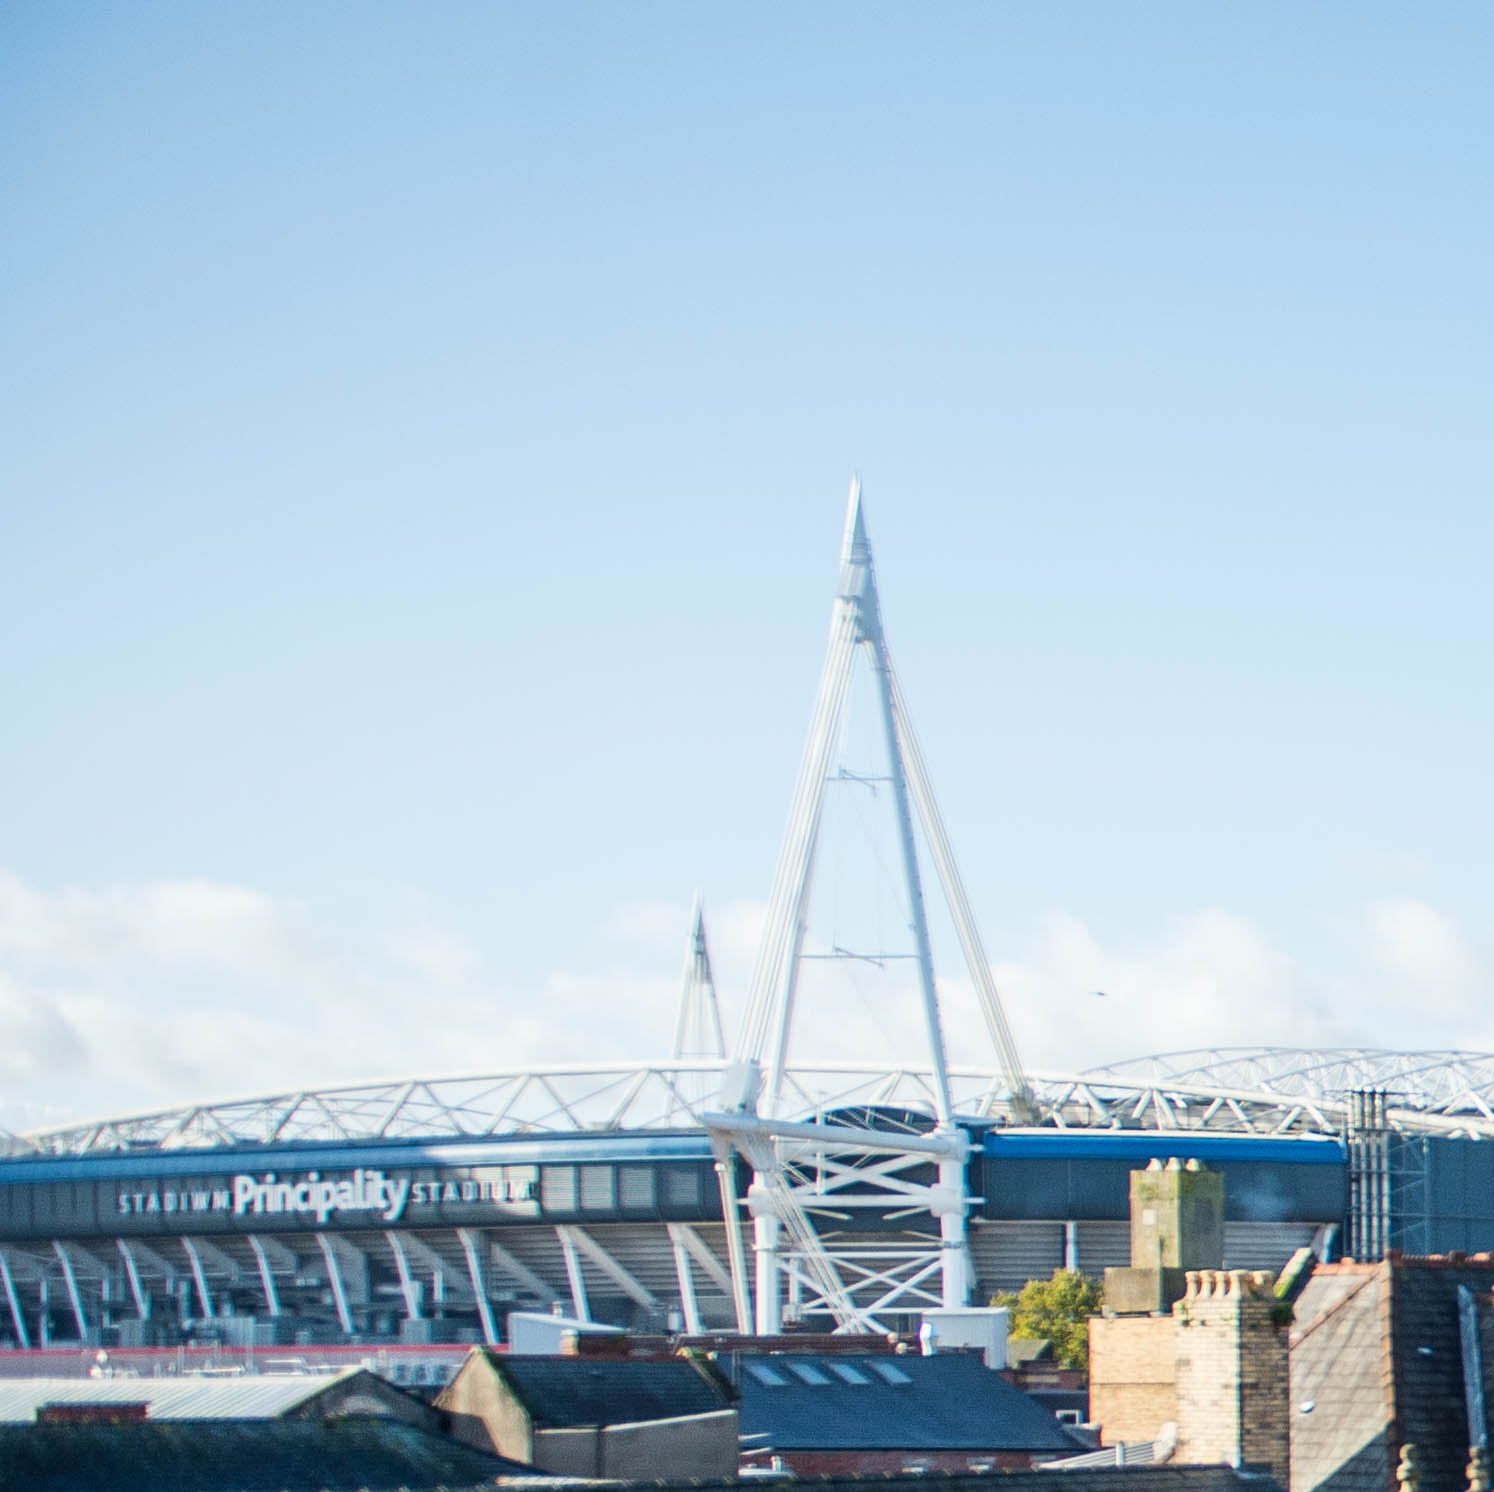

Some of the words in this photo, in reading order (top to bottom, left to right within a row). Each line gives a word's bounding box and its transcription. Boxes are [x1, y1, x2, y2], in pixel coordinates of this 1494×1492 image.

[118, 1191, 230, 1214] STADIWM
[234, 1168, 411, 1223] Principality
[411, 1177, 530, 1203] STADIUM
